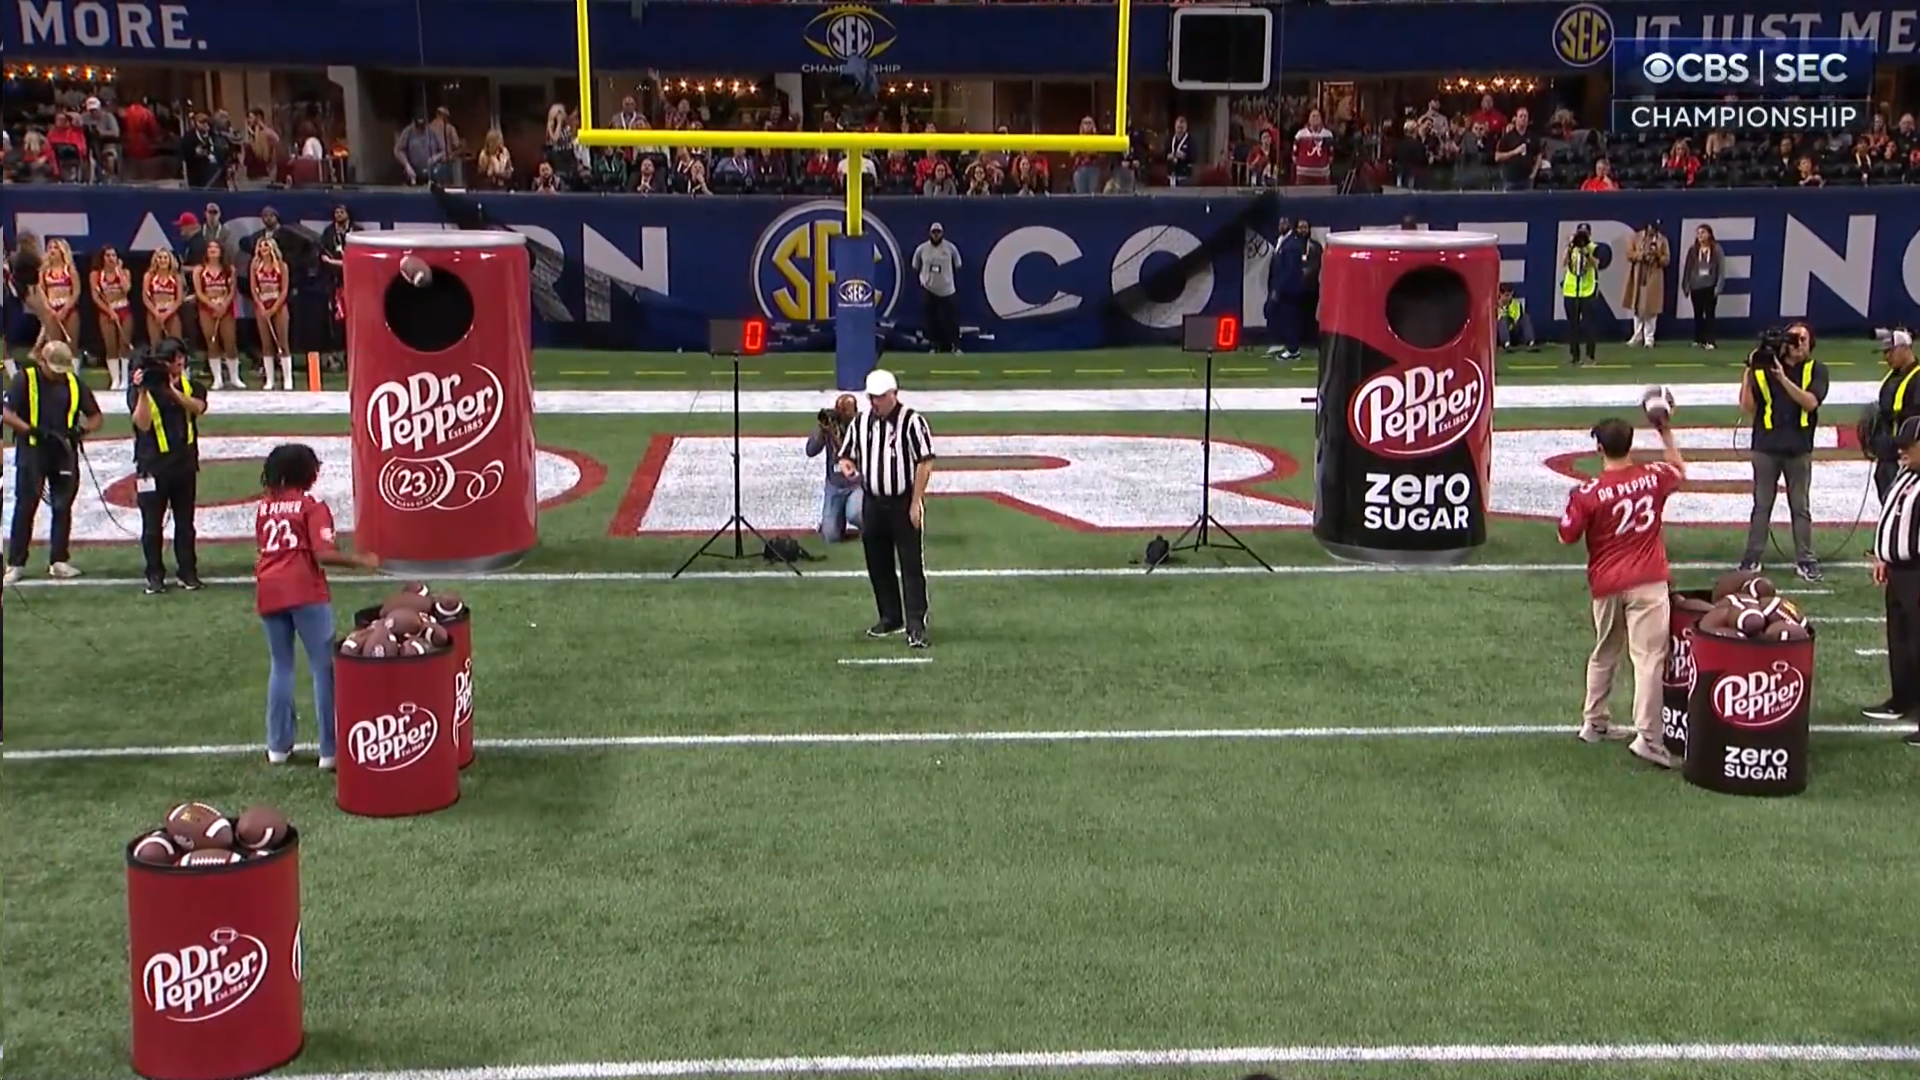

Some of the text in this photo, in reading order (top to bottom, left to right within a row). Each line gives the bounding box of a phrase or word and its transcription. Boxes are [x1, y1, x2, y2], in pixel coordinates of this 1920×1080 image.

[19, 1, 207, 49] MORE.
[831, 16, 869, 57] SEC
[1560, 11, 1606, 59] SEC
[1633, 15, 1681, 54] IT
[1839, 10, 1920, 53] ME
[802, 64, 901, 73] CHAMHIP
[772, 220, 883, 320] SE
[849, 284, 864, 301] SEC
[745, 321, 763, 349] 0
[1218, 317, 1237, 346] 0
[408, 372, 461, 414] Dr
[1404, 366, 1454, 407] Dr
[367, 381, 493, 452] Pepper
[1354, 375, 1478, 444] Pepper
[398, 469, 427, 497] 23
[1364, 473, 1470, 505] zero
[1598, 487, 1614, 501] DR
[1617, 474, 1657, 497] PEPPER
[1364, 505, 1469, 531] SUGAR
[1612, 495, 1655, 535] 23
[261, 518, 298, 552] 23
[1713, 676, 1799, 720] Pepper
[1748, 671, 1781, 695] Dr
[376, 714, 410, 742] Dr
[1661, 706, 1688, 728] er
[348, 720, 432, 766] Pepper
[1725, 746, 1788, 767] zero
[1724, 765, 1788, 780] SUGAR
[180, 945, 227, 981] Dr
[143, 951, 258, 1013] Pepper
